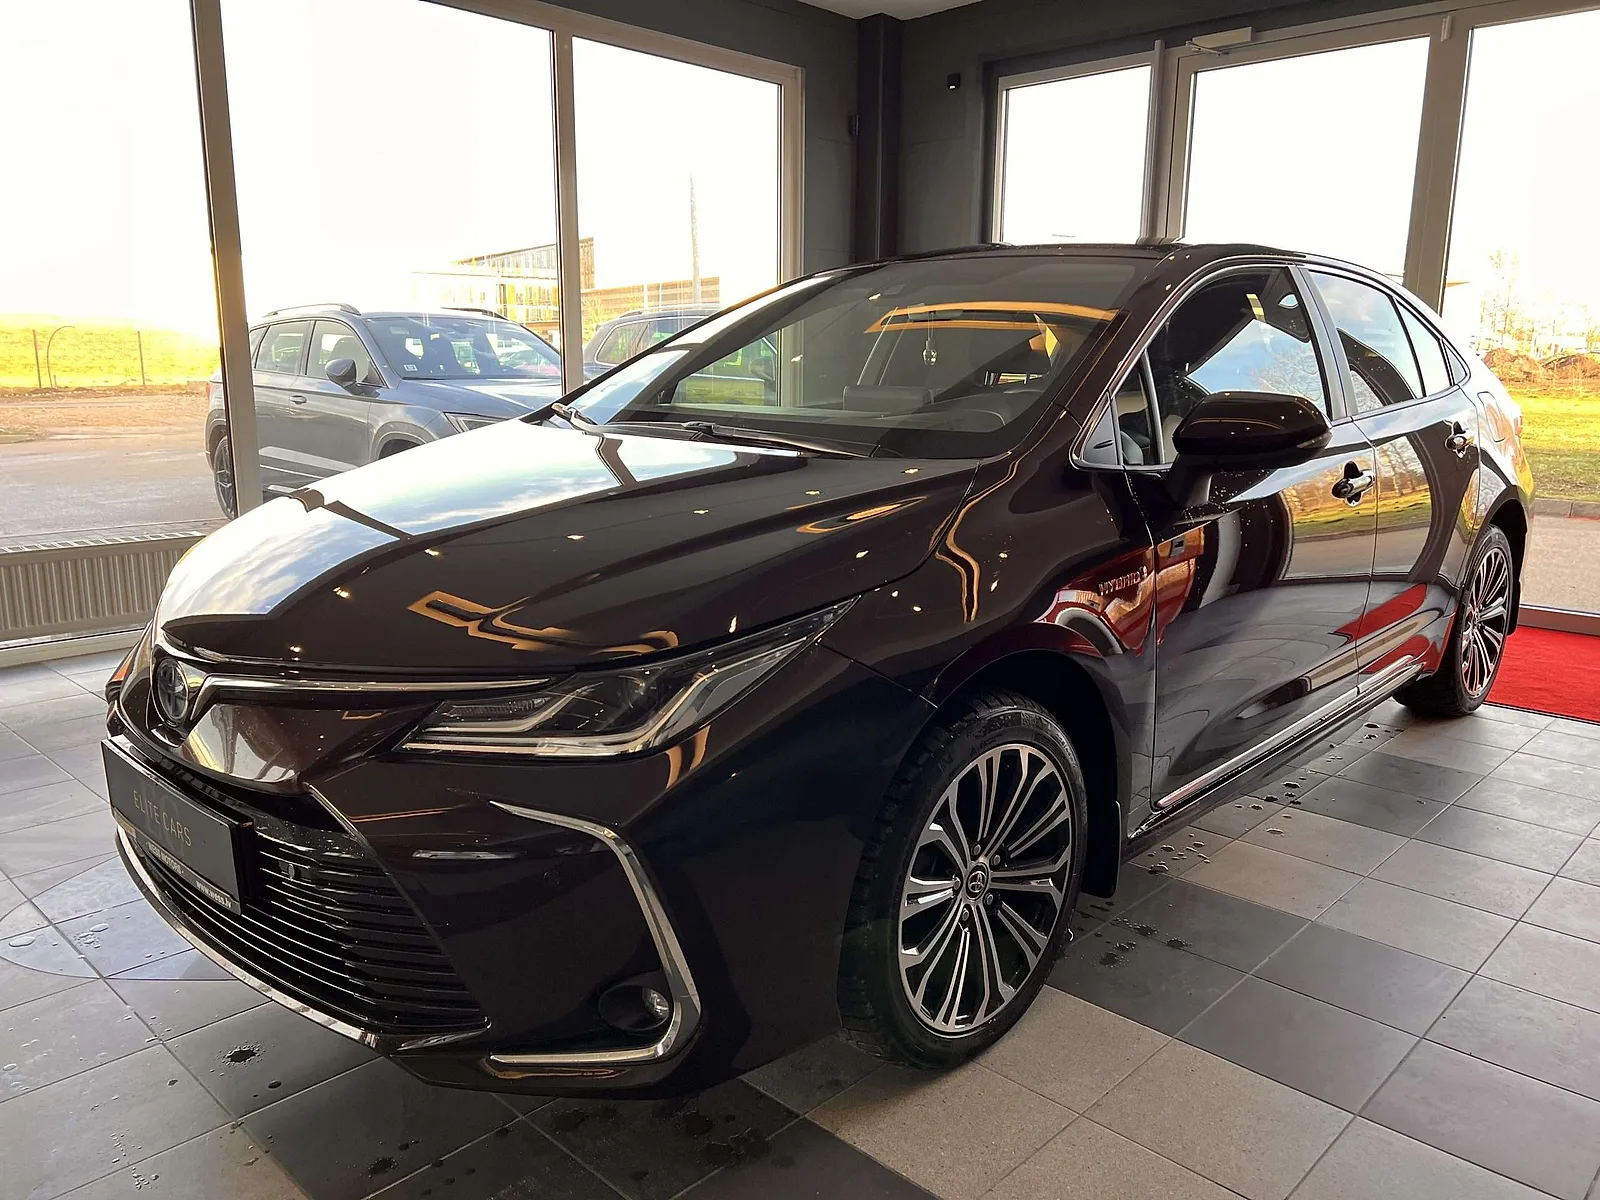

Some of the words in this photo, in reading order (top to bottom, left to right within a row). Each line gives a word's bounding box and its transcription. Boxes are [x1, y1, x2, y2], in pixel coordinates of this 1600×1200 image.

[1098, 571, 1141, 596] HYBRID
[134, 790, 160, 825] ELITE
[162, 812, 191, 846] CARS
